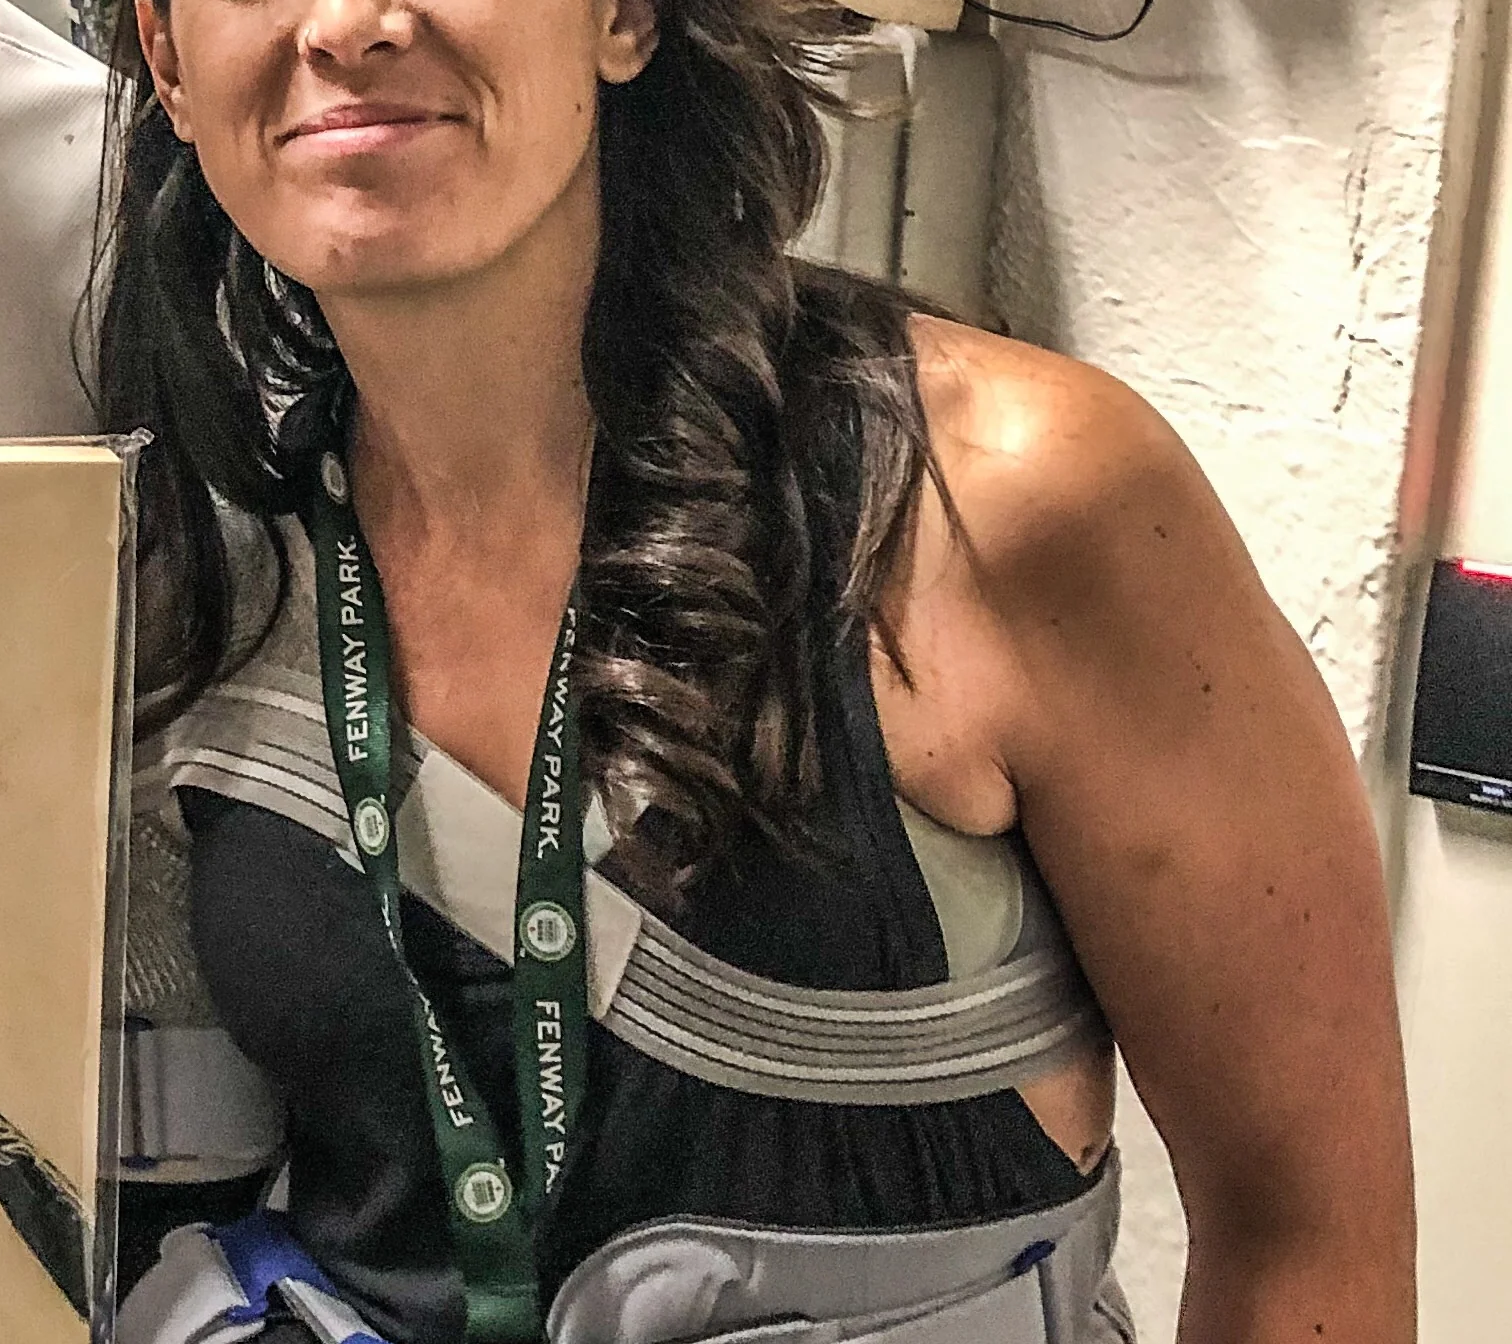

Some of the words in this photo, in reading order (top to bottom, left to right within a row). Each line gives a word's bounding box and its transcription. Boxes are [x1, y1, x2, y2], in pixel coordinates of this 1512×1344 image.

[337, 539, 366, 627] PARK
[340, 632, 370, 764] FENWAY
[538, 753, 564, 853] PARK
[535, 1000, 566, 1135] FENWAY
